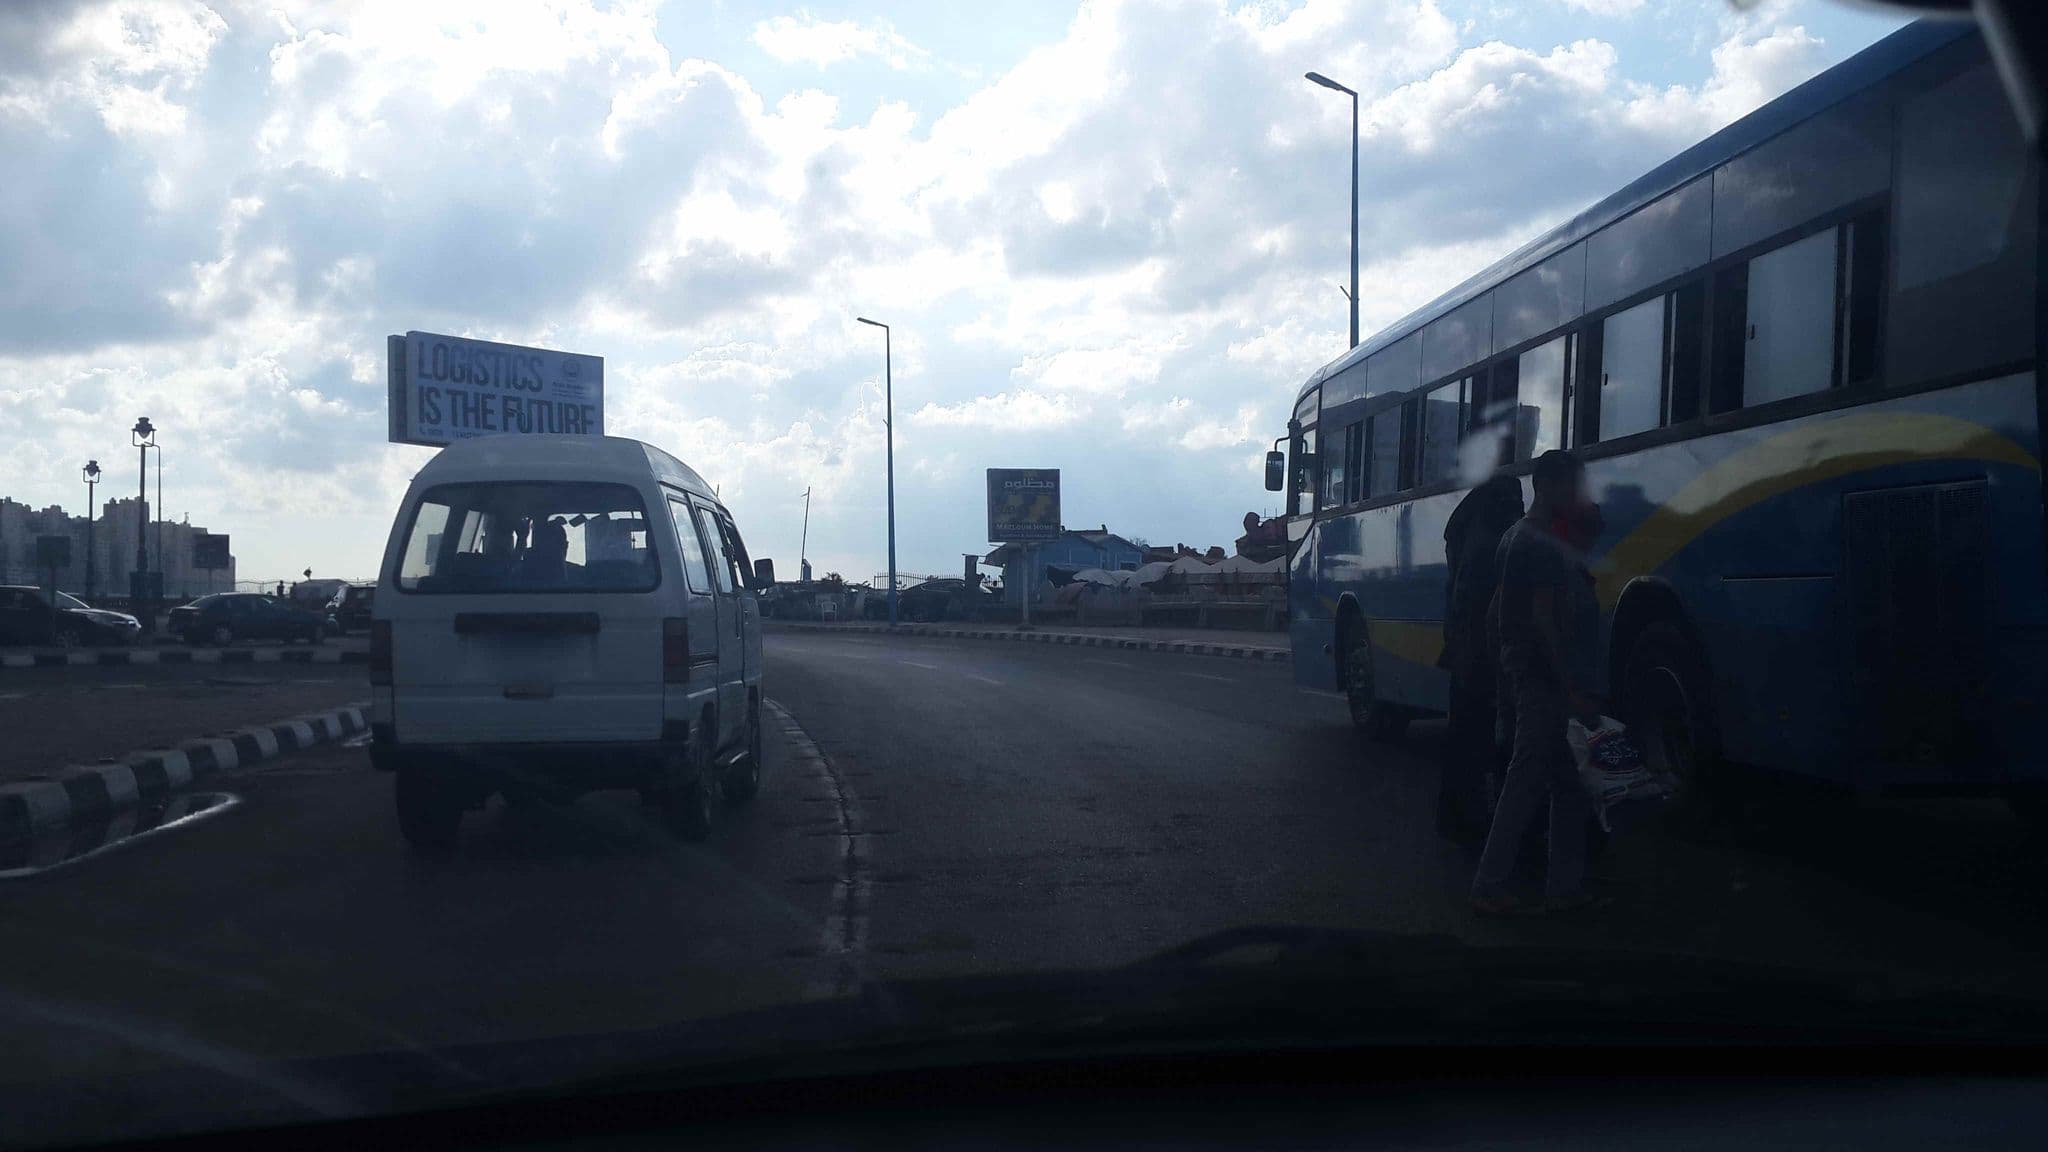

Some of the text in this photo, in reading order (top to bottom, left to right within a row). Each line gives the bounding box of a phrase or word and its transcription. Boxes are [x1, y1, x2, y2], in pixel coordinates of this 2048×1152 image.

[417, 342, 544, 393] LOGISTICS
[418, 385, 595, 435] IS THE FUTURE
[1004, 478, 1055, 489] مظلوم
